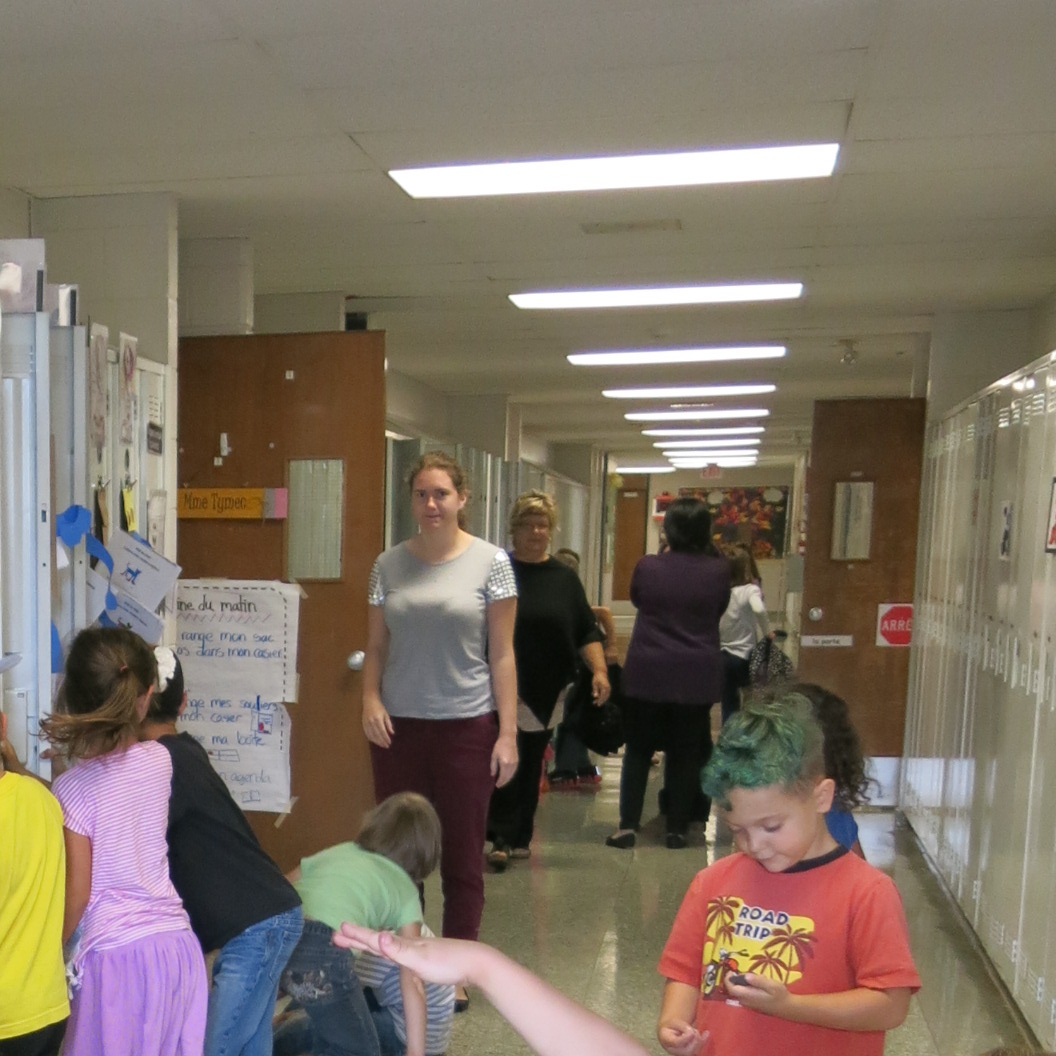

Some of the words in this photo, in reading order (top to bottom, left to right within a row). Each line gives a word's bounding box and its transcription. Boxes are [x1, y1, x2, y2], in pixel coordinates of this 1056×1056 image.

[220, 594, 258, 613] matin
[219, 631, 247, 643] mon
[252, 633, 275, 643] sac
[196, 645, 224, 658] dans
[227, 647, 251, 657] mon
[210, 698, 232, 708] mes
[739, 907, 789, 925] ROAD
[735, 922, 771, 939] TRIP
